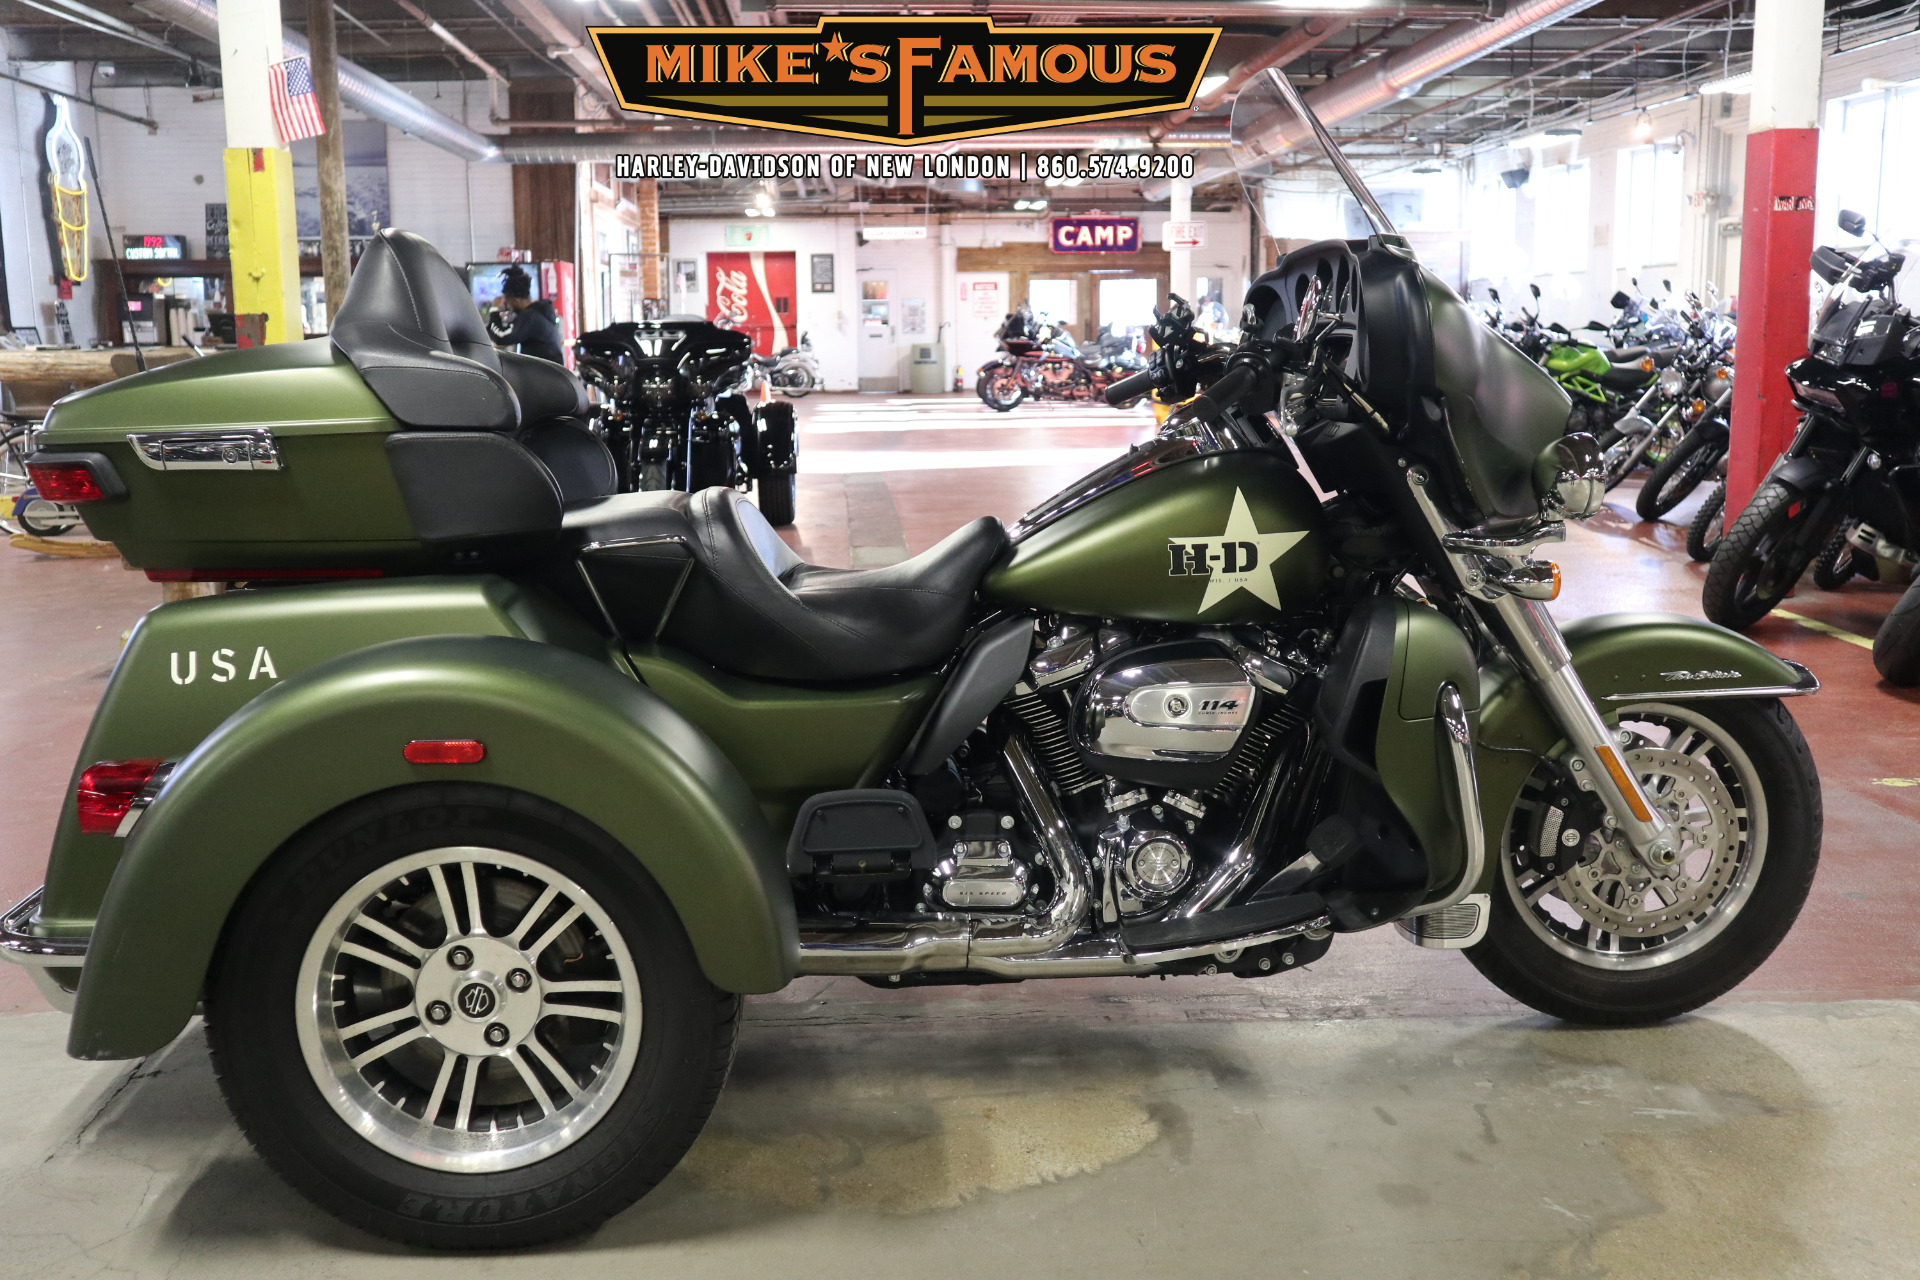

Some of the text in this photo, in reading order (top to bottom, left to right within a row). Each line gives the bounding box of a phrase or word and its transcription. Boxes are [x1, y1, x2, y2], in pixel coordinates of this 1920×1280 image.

[144, 236, 163, 247] 1992
[1058, 225, 1134, 247] CAMP
[715, 266, 748, 322] Cola
[1167, 541, 1258, 576] H-D
[171, 646, 278, 685] USA
[1200, 700, 1239, 711] 114
